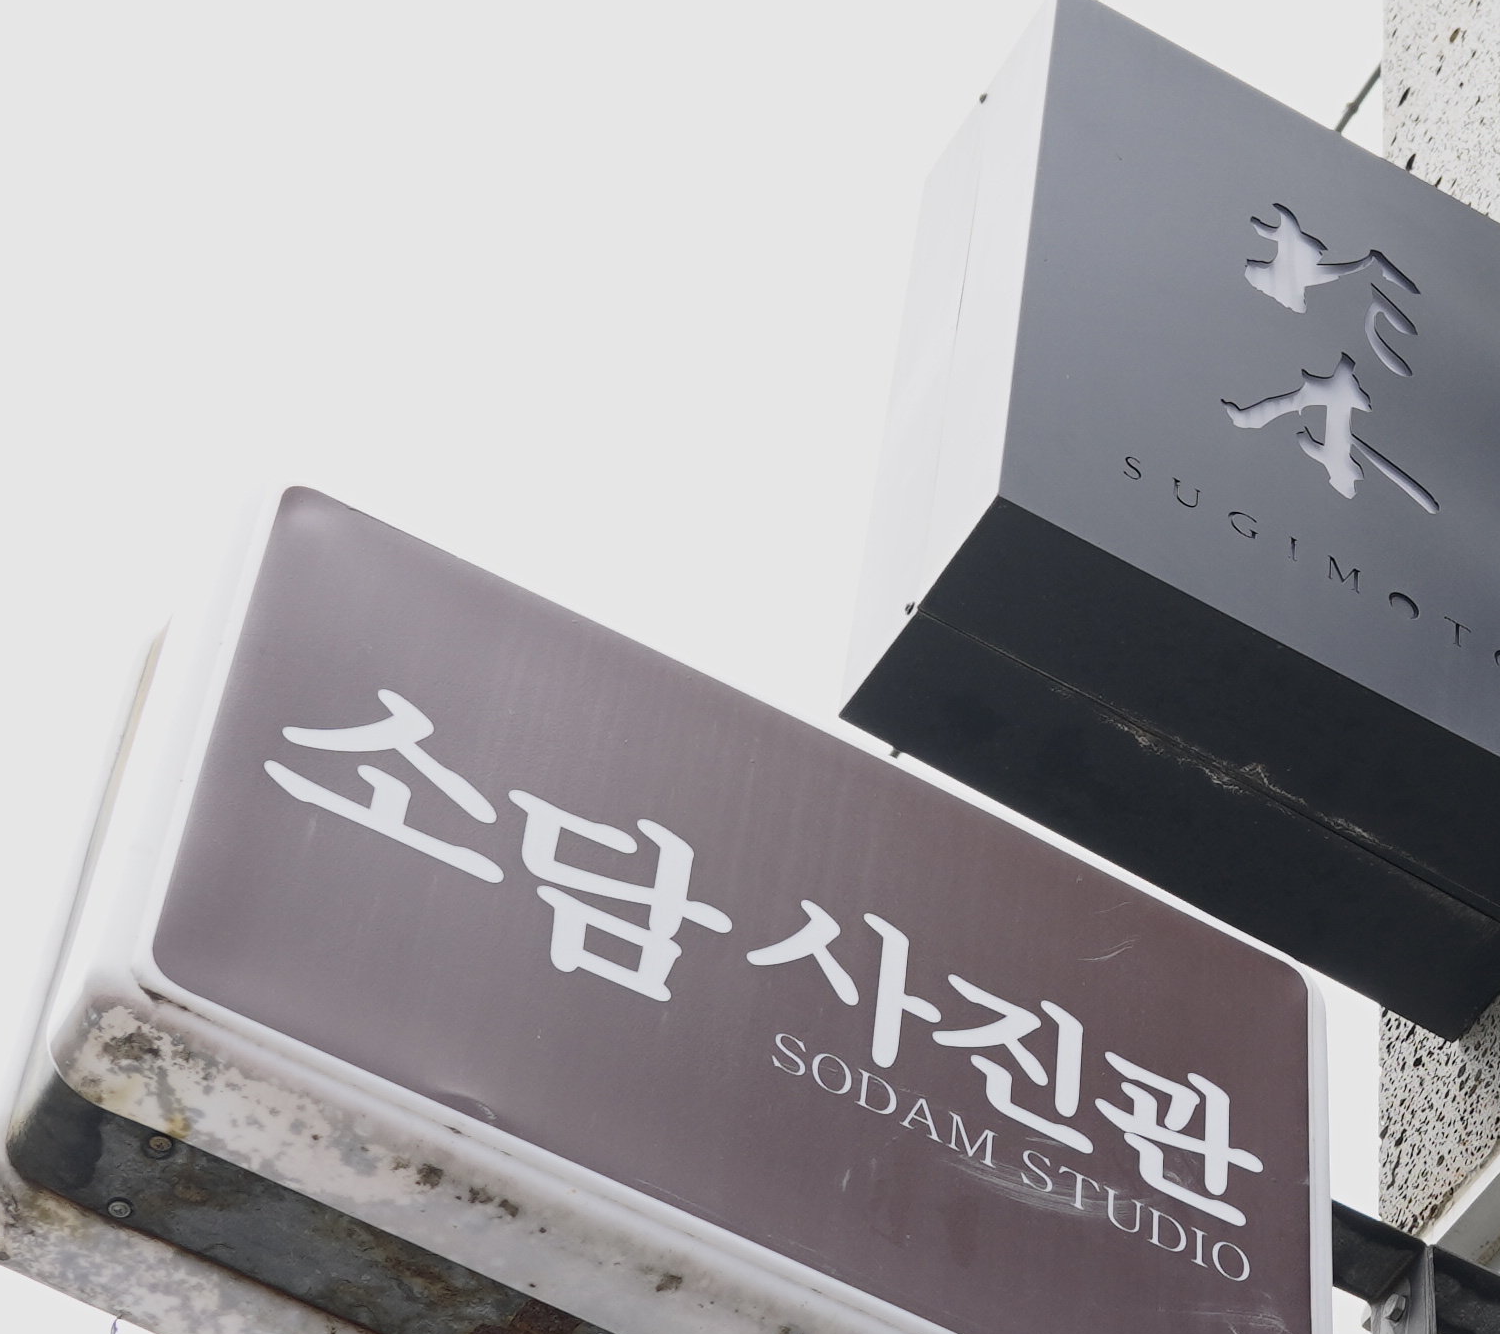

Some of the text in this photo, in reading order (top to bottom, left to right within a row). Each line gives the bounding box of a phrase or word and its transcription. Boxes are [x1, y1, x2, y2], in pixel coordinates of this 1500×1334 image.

[263, 688, 1264, 1228] 소담 사진관
[772, 1032, 1253, 1284] SODAM STUDIO
